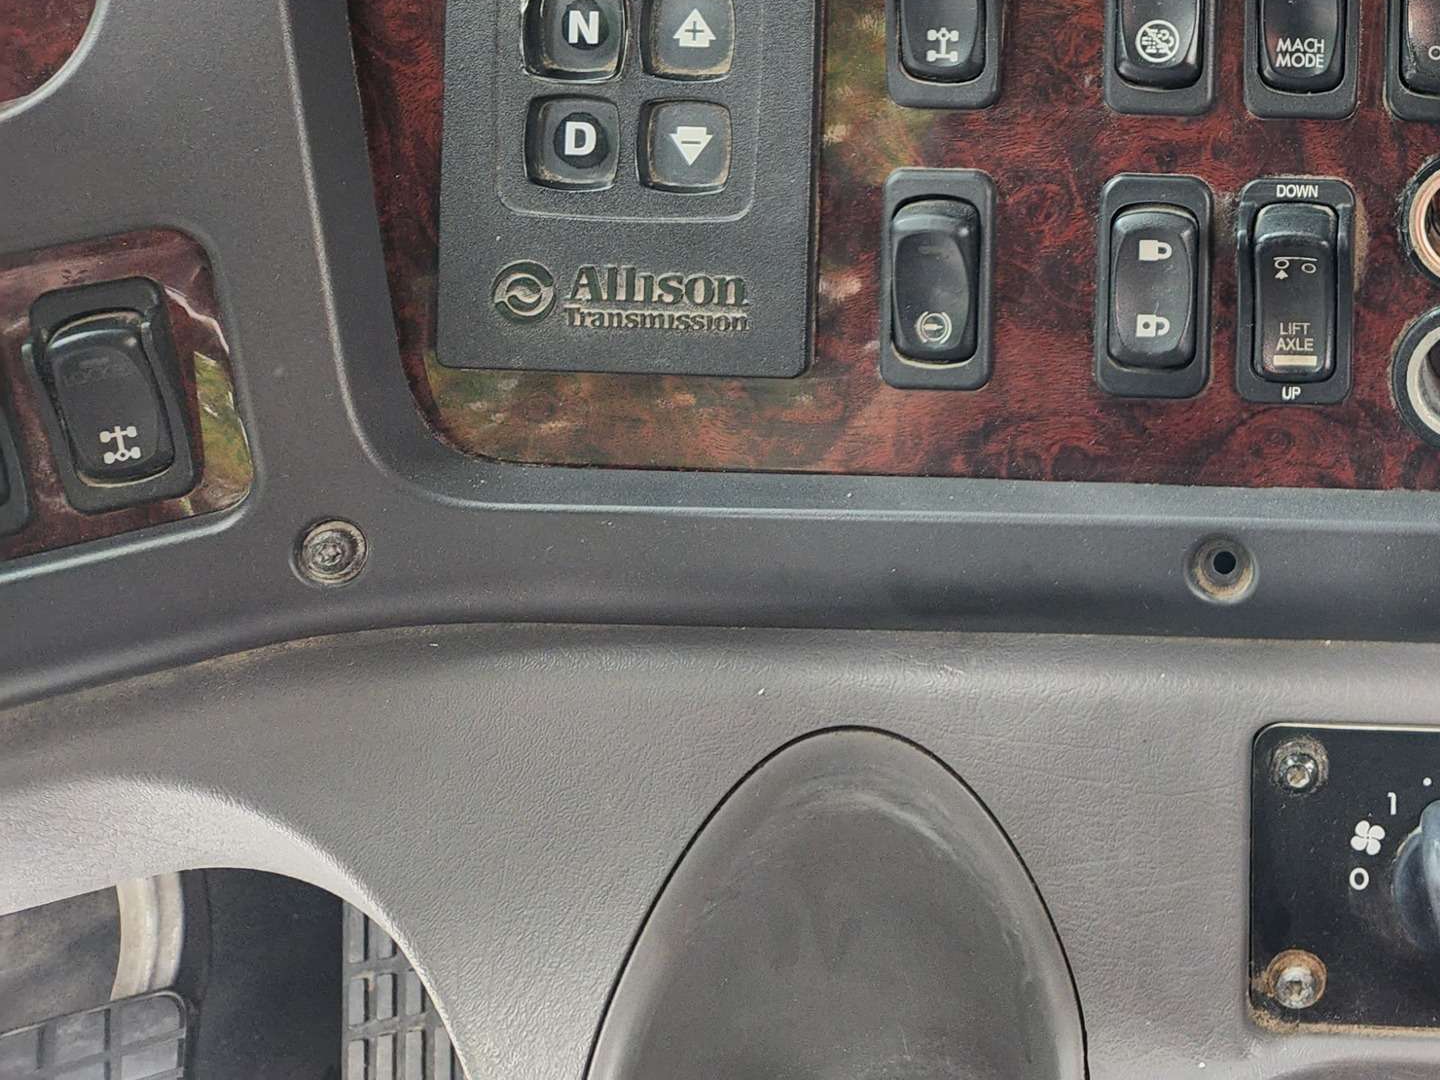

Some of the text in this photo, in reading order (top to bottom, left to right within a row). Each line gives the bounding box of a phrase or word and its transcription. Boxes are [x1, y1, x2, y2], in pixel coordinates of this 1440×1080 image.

[568, 10, 600, 45] N
[1276, 37, 1325, 53] MACH
[1275, 53, 1324, 68] MODE
[564, 121, 597, 156] D
[1276, 184, 1319, 198] DOWN
[569, 264, 750, 307] Allison
[562, 305, 751, 332] Transmission
[1279, 323, 1311, 336] LIFT
[1276, 337, 1314, 352] AXLE
[1281, 386, 1301, 400] UP
[1387, 792, 1398, 816] 1
